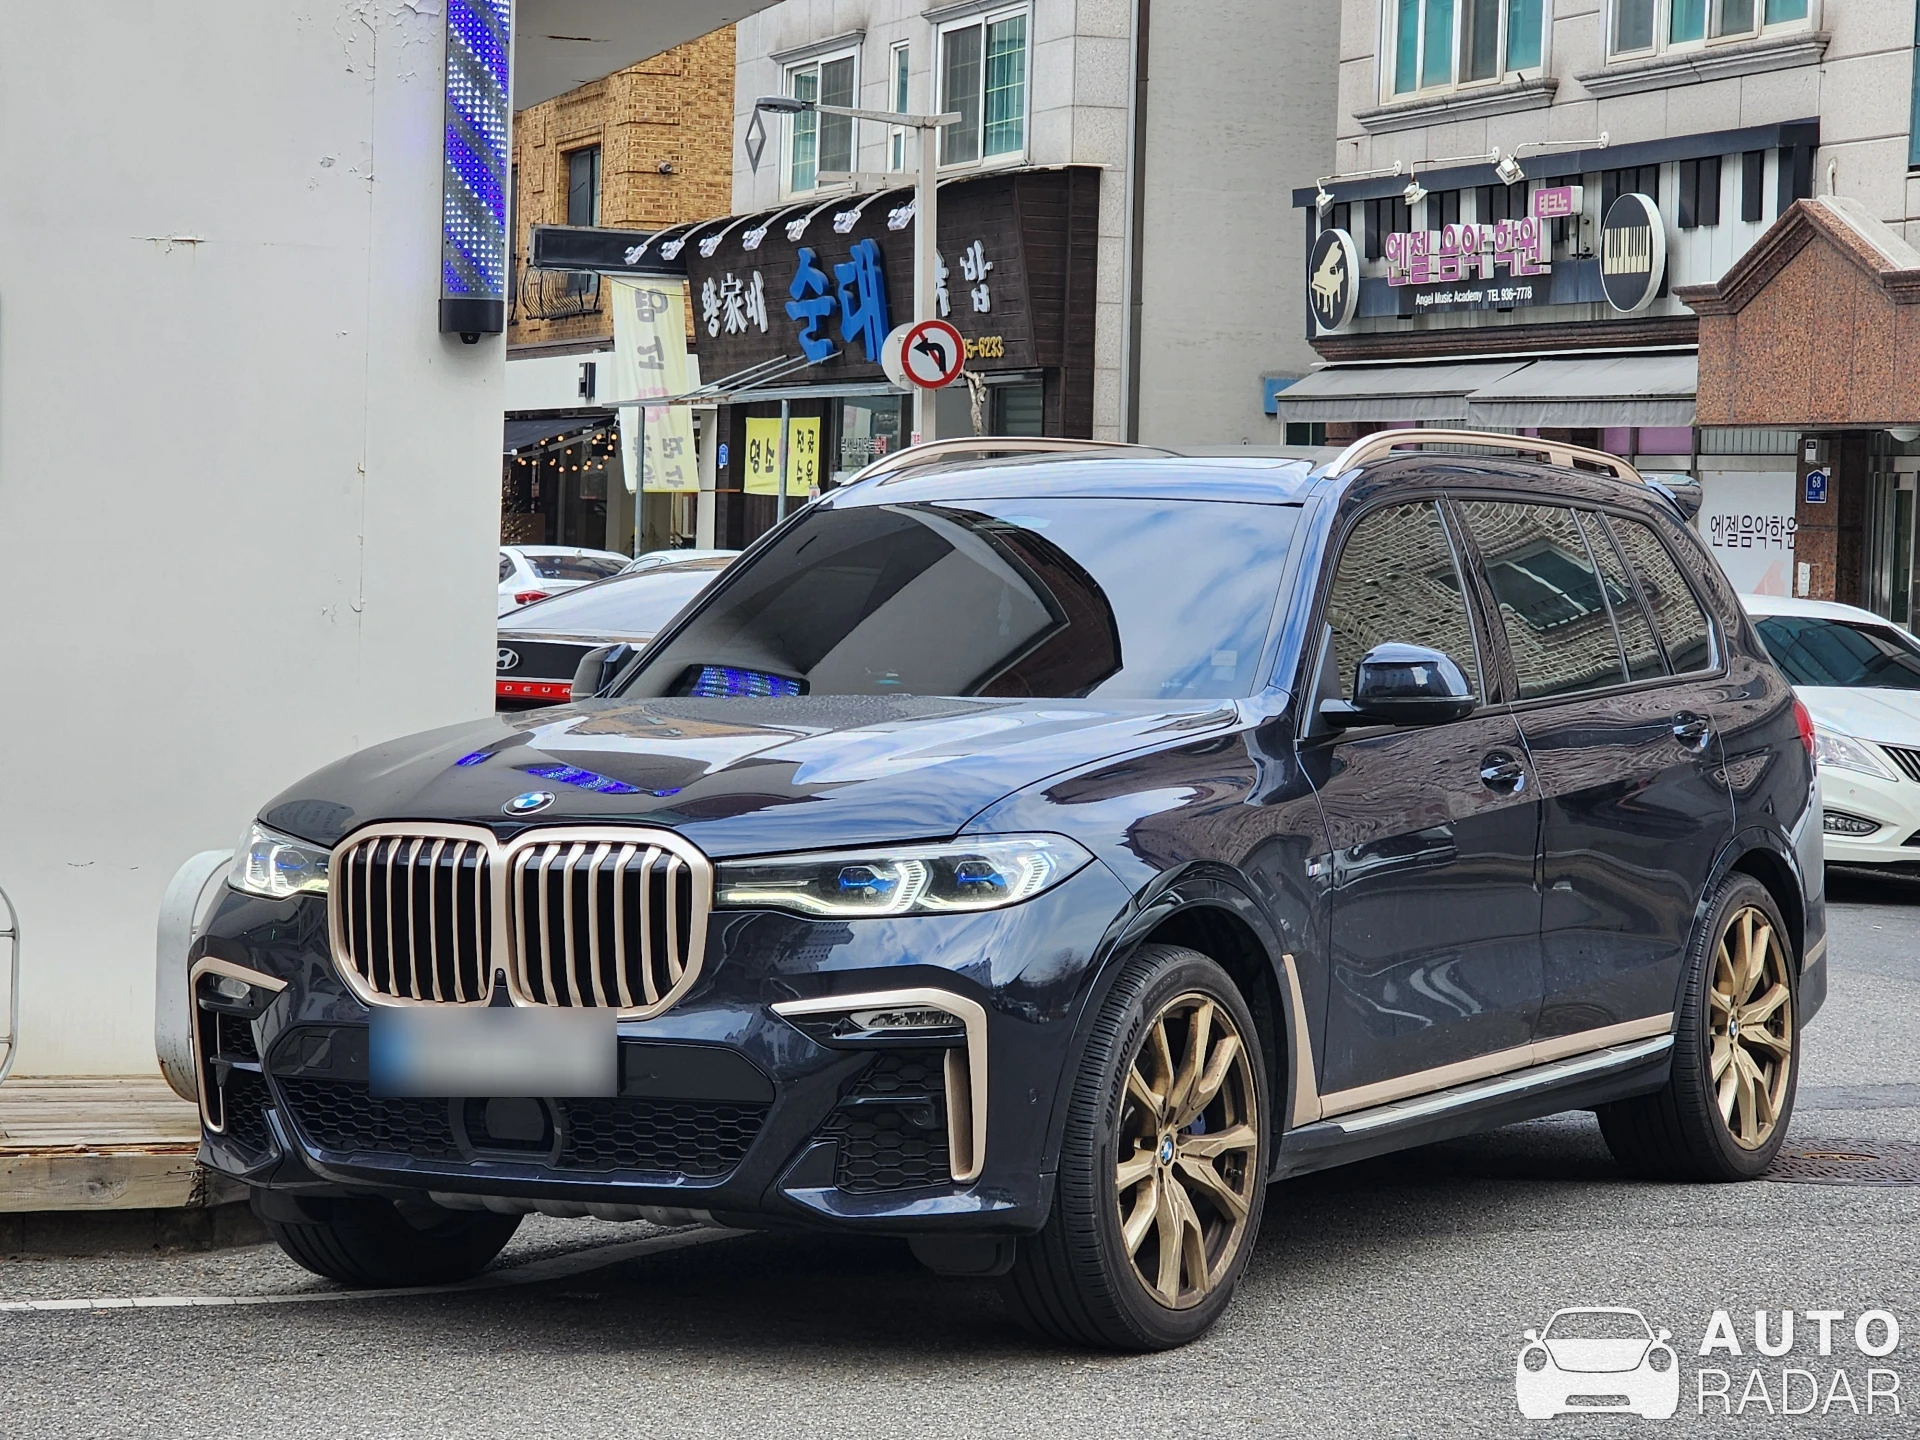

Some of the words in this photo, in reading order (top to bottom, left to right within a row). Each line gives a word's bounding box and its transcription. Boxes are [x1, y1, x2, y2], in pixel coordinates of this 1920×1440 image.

[1539, 193, 1568, 214] 테크노
[785, 238, 890, 365] 순대
[1415, 292, 1434, 306] Angel
[1435, 290, 1454, 304] Music
[1454, 289, 1483, 303] Academy
[1487, 288, 1500, 302] TEL
[1501, 286, 1533, 302] 936-7778
[1812, 475, 1822, 488] 68
